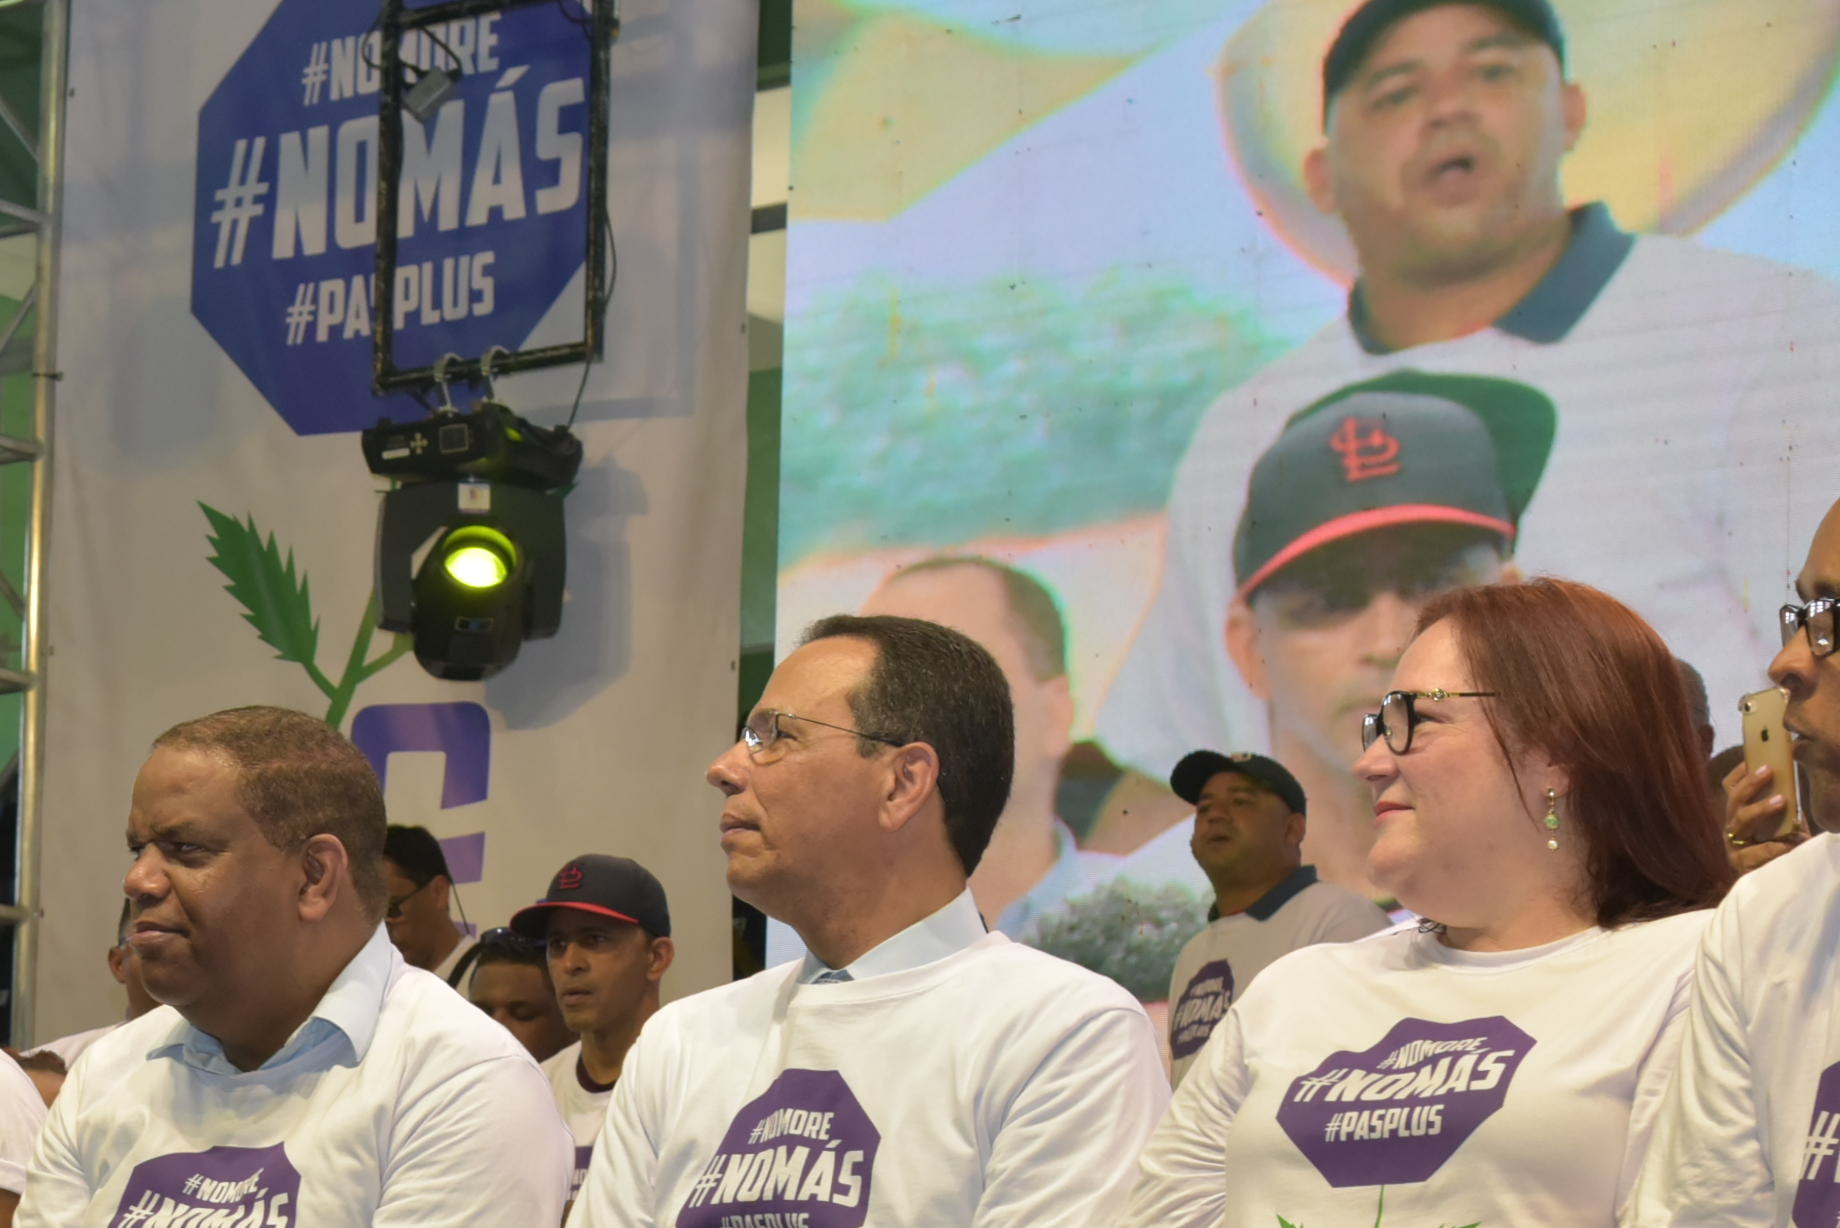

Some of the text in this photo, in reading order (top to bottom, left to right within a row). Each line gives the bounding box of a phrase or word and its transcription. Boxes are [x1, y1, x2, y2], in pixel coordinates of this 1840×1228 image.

[286, 250, 496, 347] #PAPLUS
[1293, 1047, 1516, 1103] #NOMÁS
[1376, 1036, 1488, 1070] #NOMORE
[747, 1108, 835, 1145] #NOMORE
[1324, 1104, 1445, 1143] #PASPLUS
[688, 1139, 865, 1209] #NOMÁS
